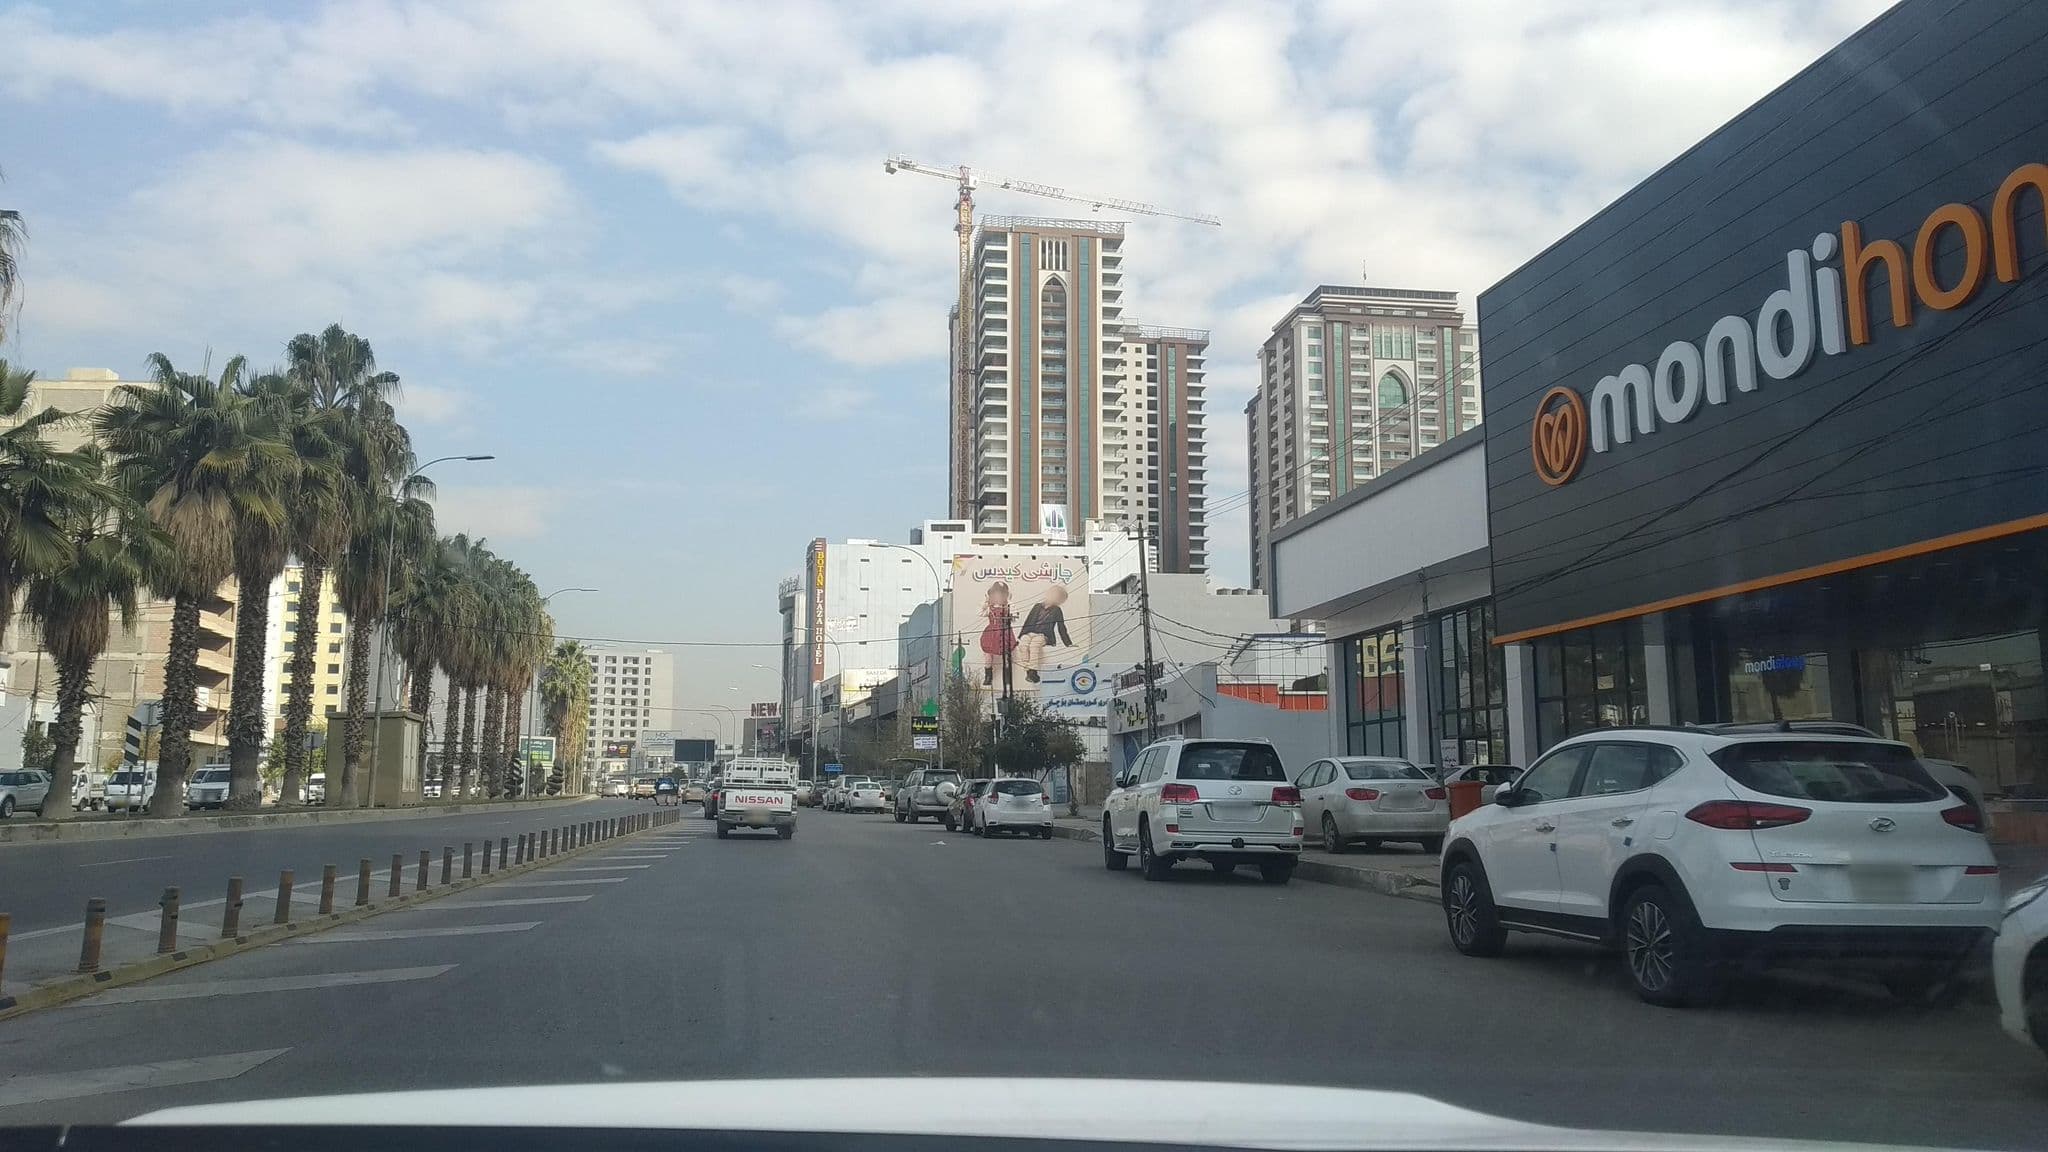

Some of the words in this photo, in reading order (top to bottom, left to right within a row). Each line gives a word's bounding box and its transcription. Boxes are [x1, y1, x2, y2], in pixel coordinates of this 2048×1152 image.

[816, 551, 825, 587] BOTAN
[816, 588, 824, 625] PLAZA
[815, 627, 823, 665] HOTEL
[750, 702, 778, 718] NEW
[735, 795, 784, 805] NISSAN
